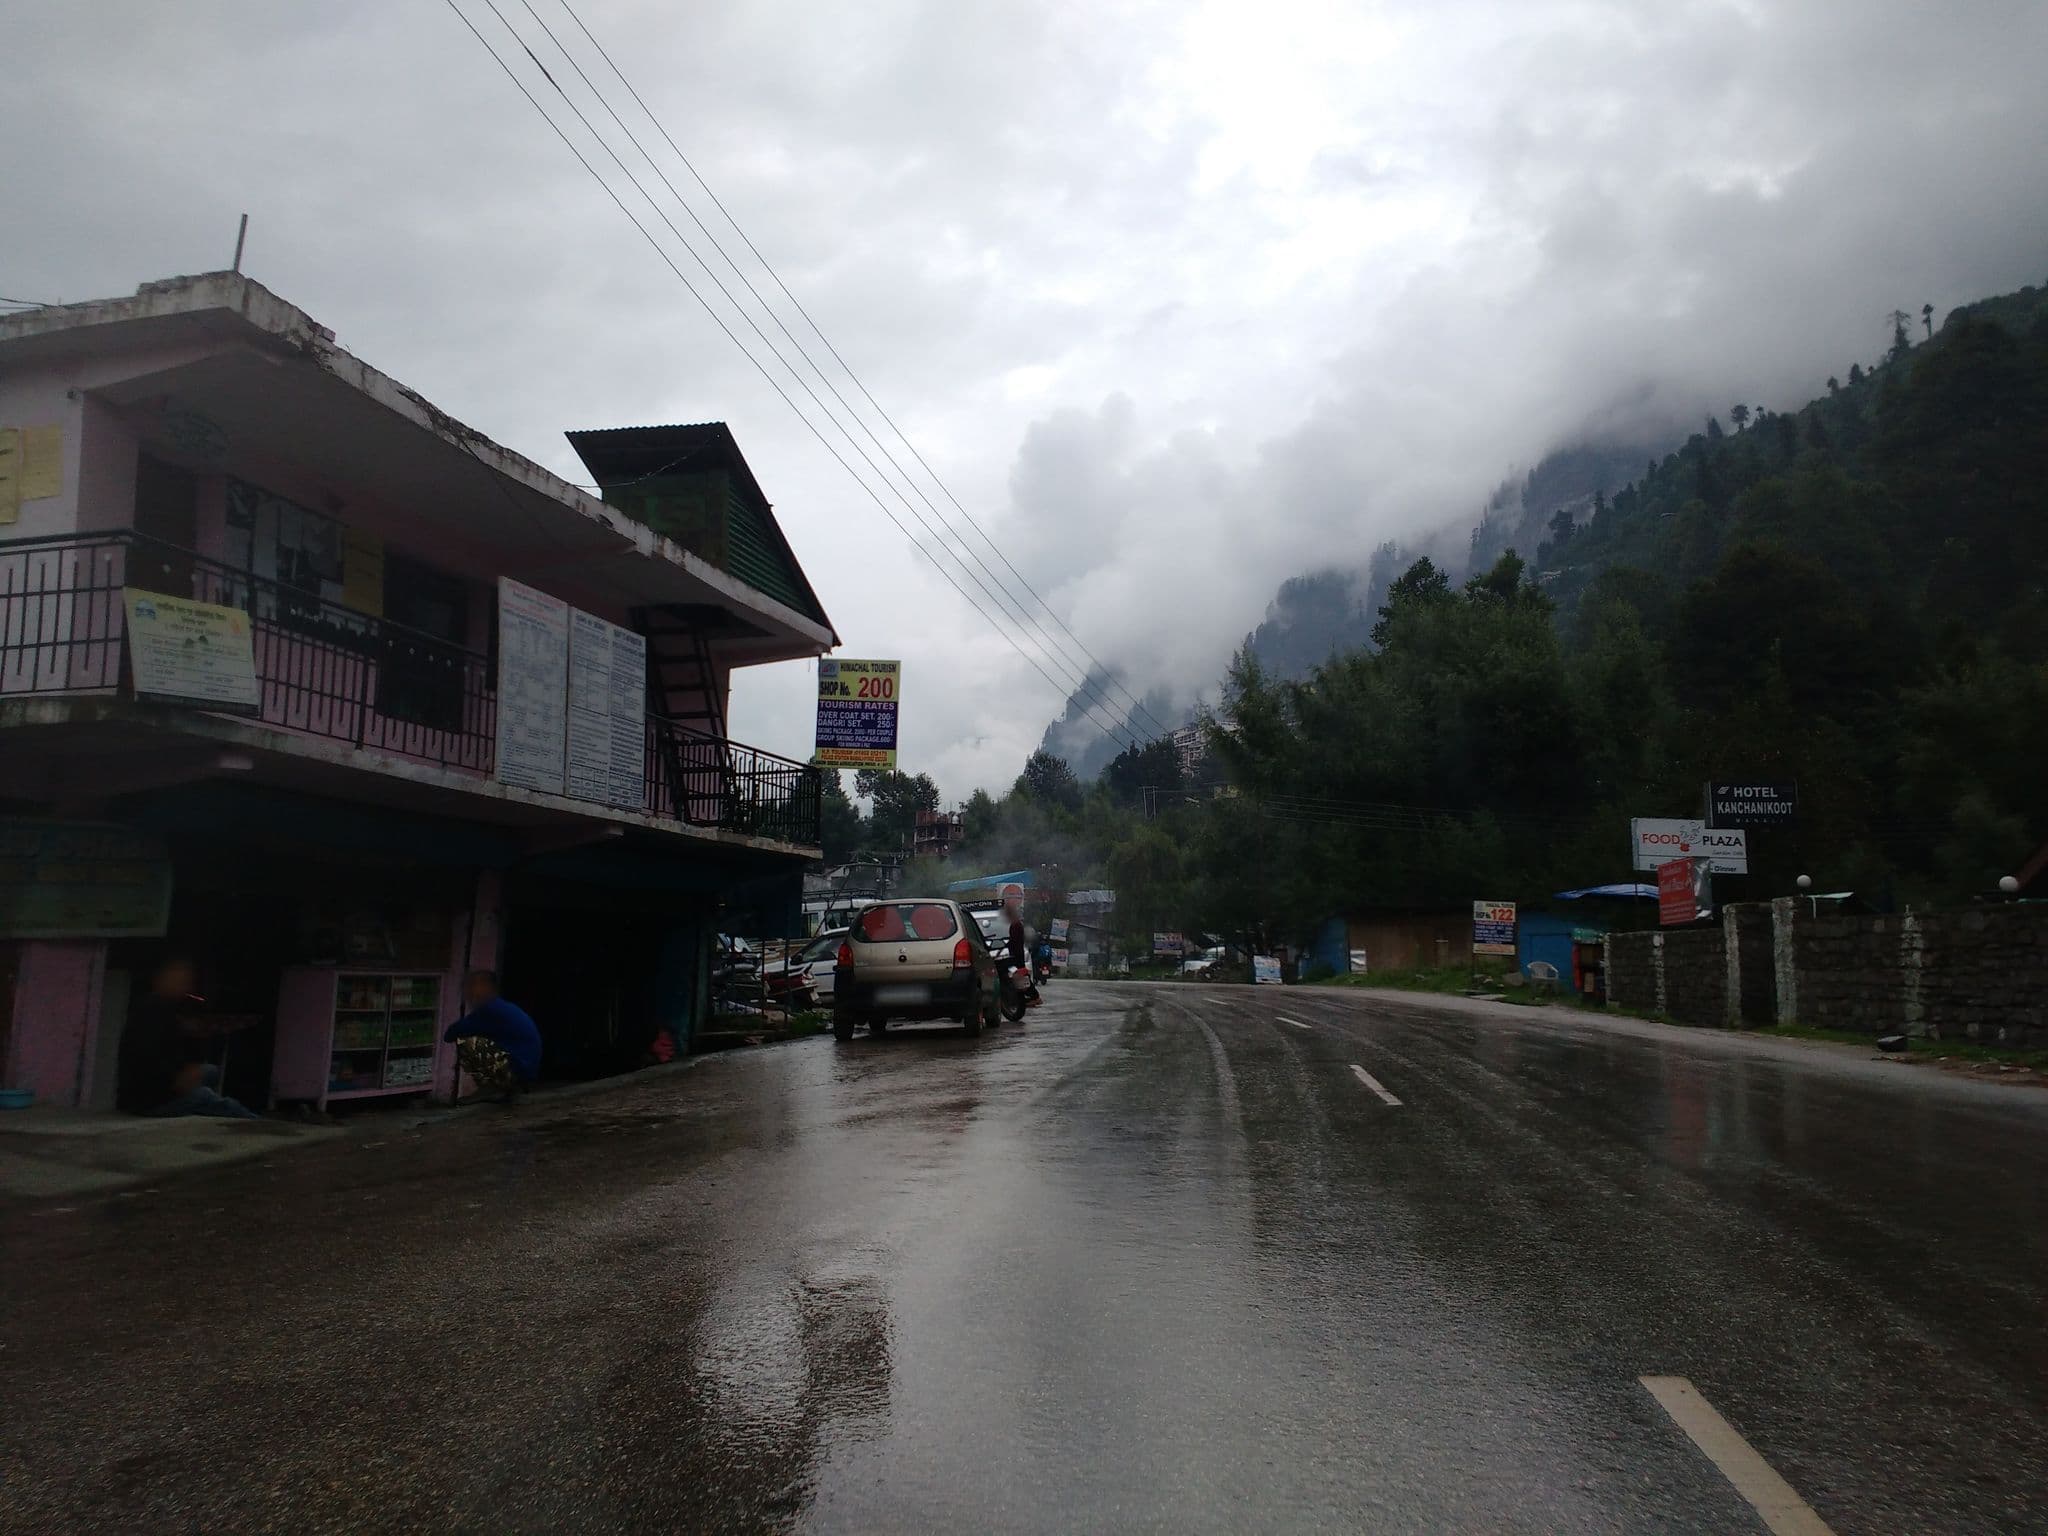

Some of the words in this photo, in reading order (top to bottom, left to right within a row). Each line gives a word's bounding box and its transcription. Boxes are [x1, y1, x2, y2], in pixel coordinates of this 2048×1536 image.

[871, 663, 897, 673] TOURISM
[820, 681, 839, 695] SHOP
[858, 677, 893, 698] 200
[819, 701, 862, 709] TOURISM
[864, 702, 895, 710] RATES
[818, 711, 838, 719] OVER
[839, 711, 859, 720] COAT
[818, 719, 845, 727] DANGRI
[1733, 786, 1778, 798] HOTEL
[1717, 801, 1793, 815] KANCHANIKOOT
[1642, 833, 1680, 845] FOOD
[1702, 835, 1743, 847] PLAZA
[1491, 909, 1513, 921] 122
